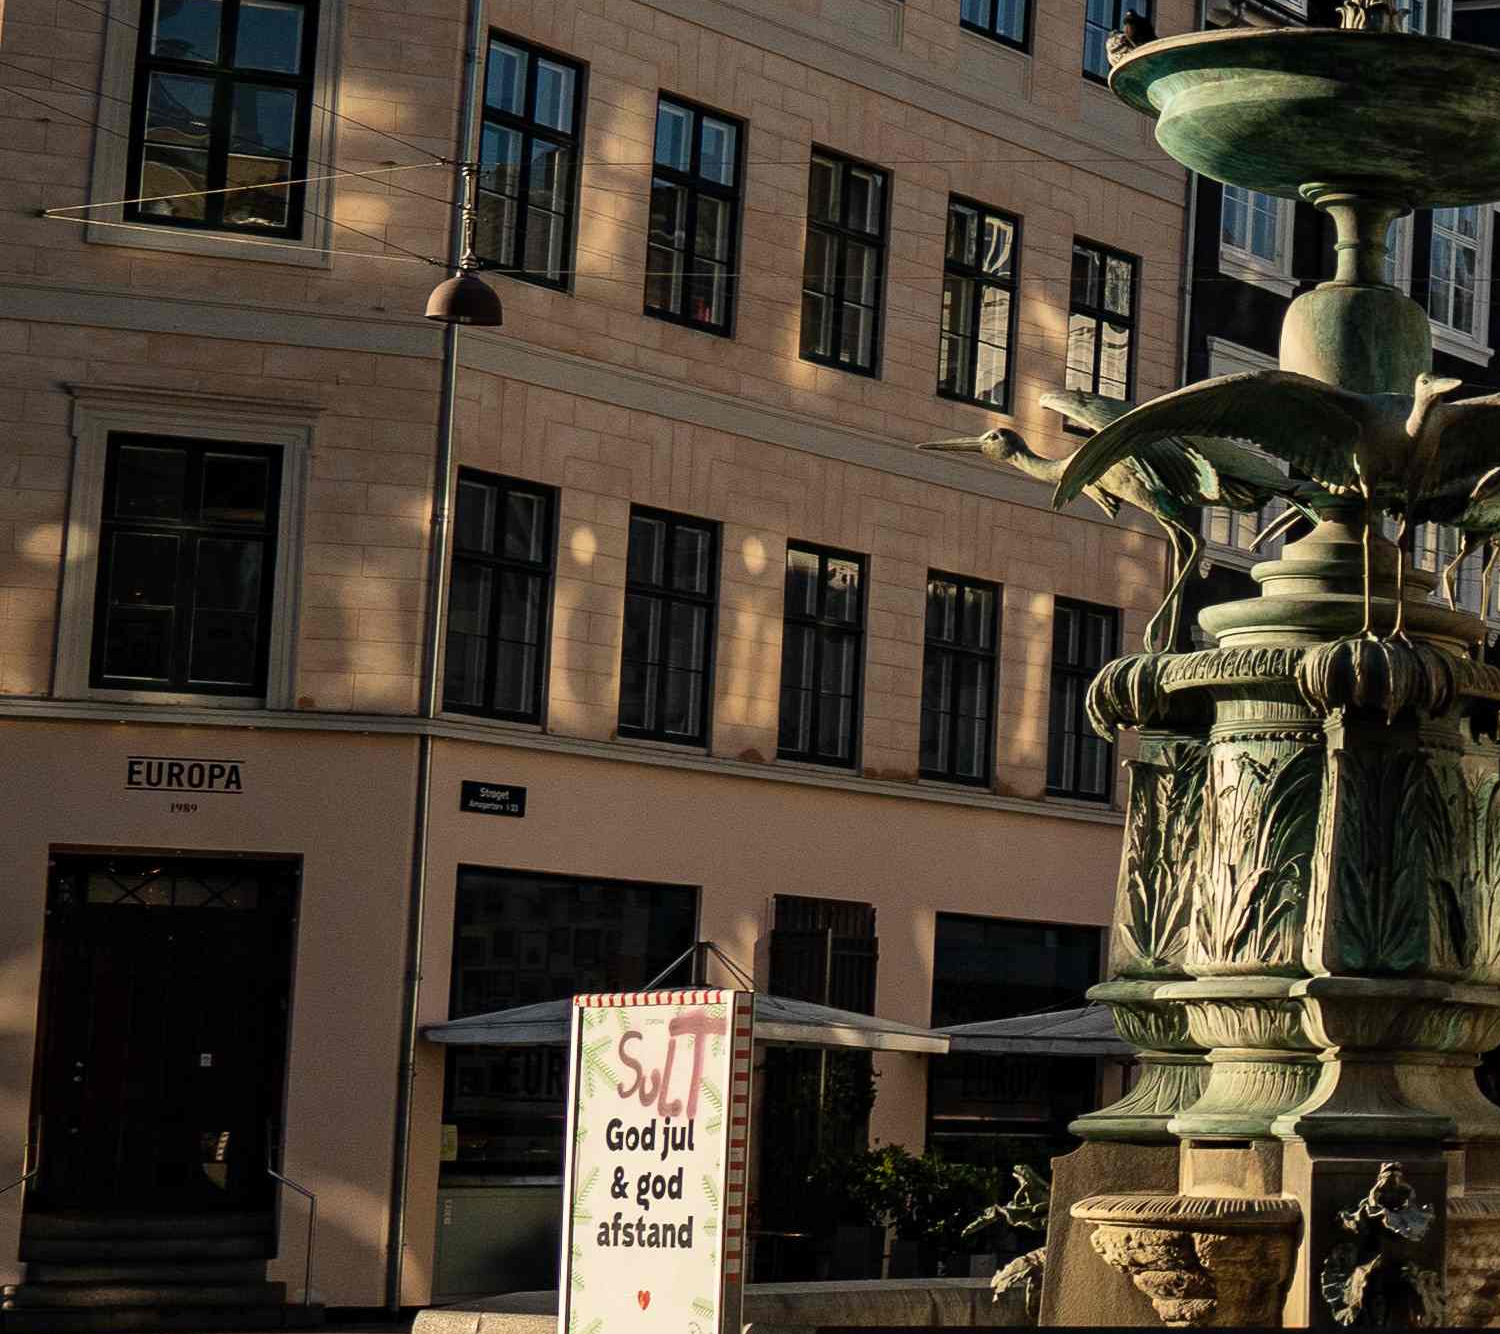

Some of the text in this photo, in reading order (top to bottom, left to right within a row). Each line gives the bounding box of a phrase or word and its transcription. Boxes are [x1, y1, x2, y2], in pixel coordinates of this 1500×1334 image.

[127, 760, 242, 789] EUROPA
[170, 802, 198, 813] 1989
[606, 1117, 695, 1161] God jul
[610, 1166, 684, 1211] & god
[596, 1212, 694, 1249] afstand
